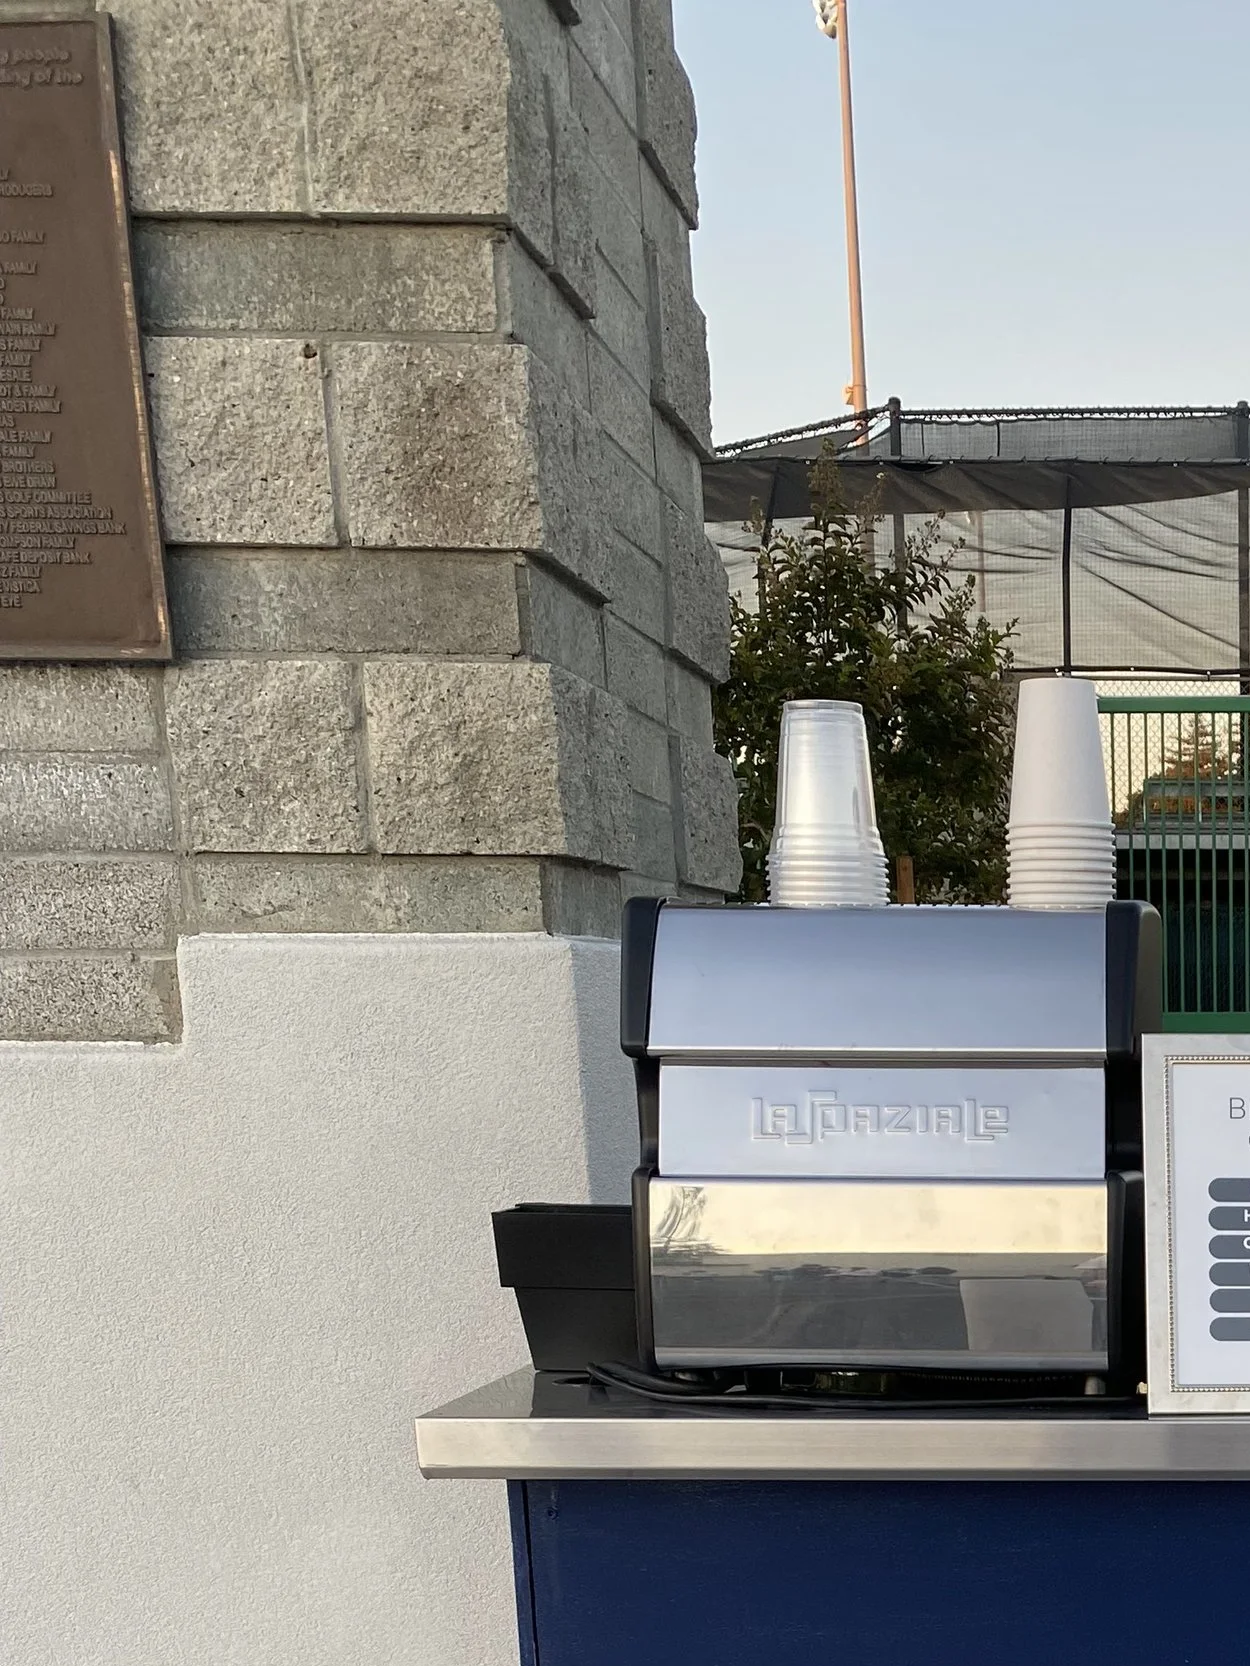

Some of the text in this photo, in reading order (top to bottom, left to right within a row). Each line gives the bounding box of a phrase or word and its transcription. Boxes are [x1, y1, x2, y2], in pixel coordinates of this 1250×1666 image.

[11, 230, 46, 244] FAMILY
[4, 261, 38, 275] FAMILY
[1, 307, 35, 321] FAMILY
[8, 338, 41, 352] FAMILY
[19, 430, 53, 444] FAMILY
[2, 445, 36, 459] FAMILY
[2, 460, 55, 474] BROTHERS
[6, 505, 46, 519] SPORTS
[46, 505, 113, 520] ASSOCIATION
[10, 520, 54, 534] FEDERAL
[54, 520, 98, 535] SAVINGS
[42, 536, 76, 550] FAMILY
[9, 566, 42, 579] FAMILY
